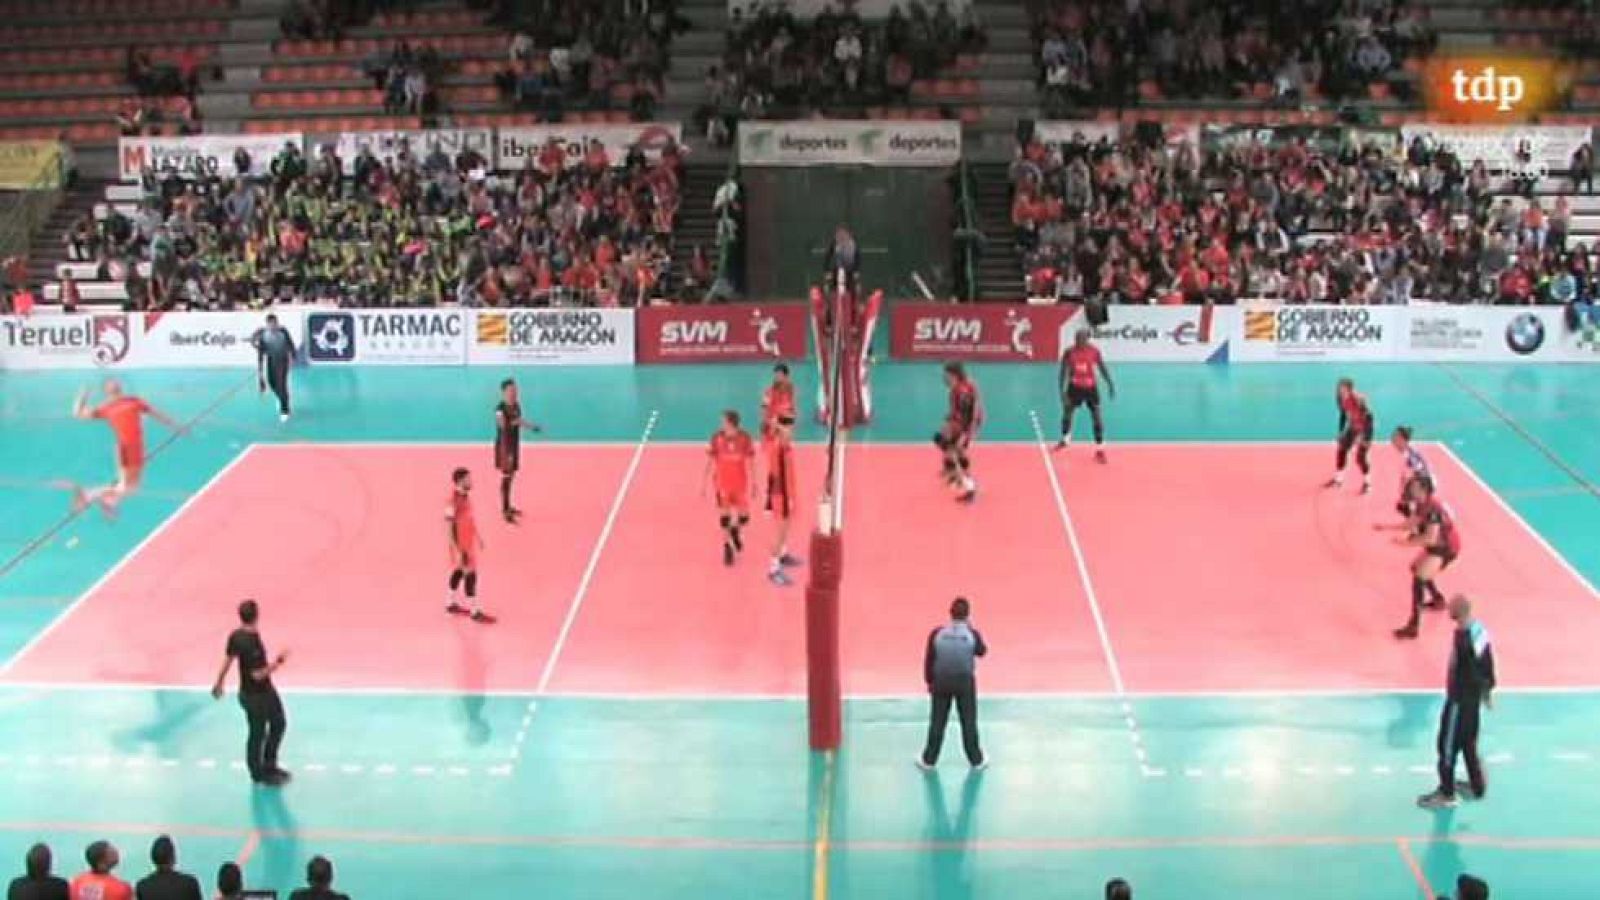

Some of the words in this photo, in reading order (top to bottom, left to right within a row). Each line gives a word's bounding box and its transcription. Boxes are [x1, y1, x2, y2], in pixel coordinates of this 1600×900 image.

[779, 133, 848, 153] deportes
[890, 132, 957, 153] deportes
[358, 313, 461, 337] TARMAC
[508, 310, 603, 328] GOBIERNO
[1277, 308, 1371, 325] GOBIERNO
[3, 319, 91, 346] Teruel
[508, 327, 534, 345] DE
[660, 320, 729, 343] SVM
[913, 319, 983, 343] SVM
[1277, 325, 1302, 342] DE
